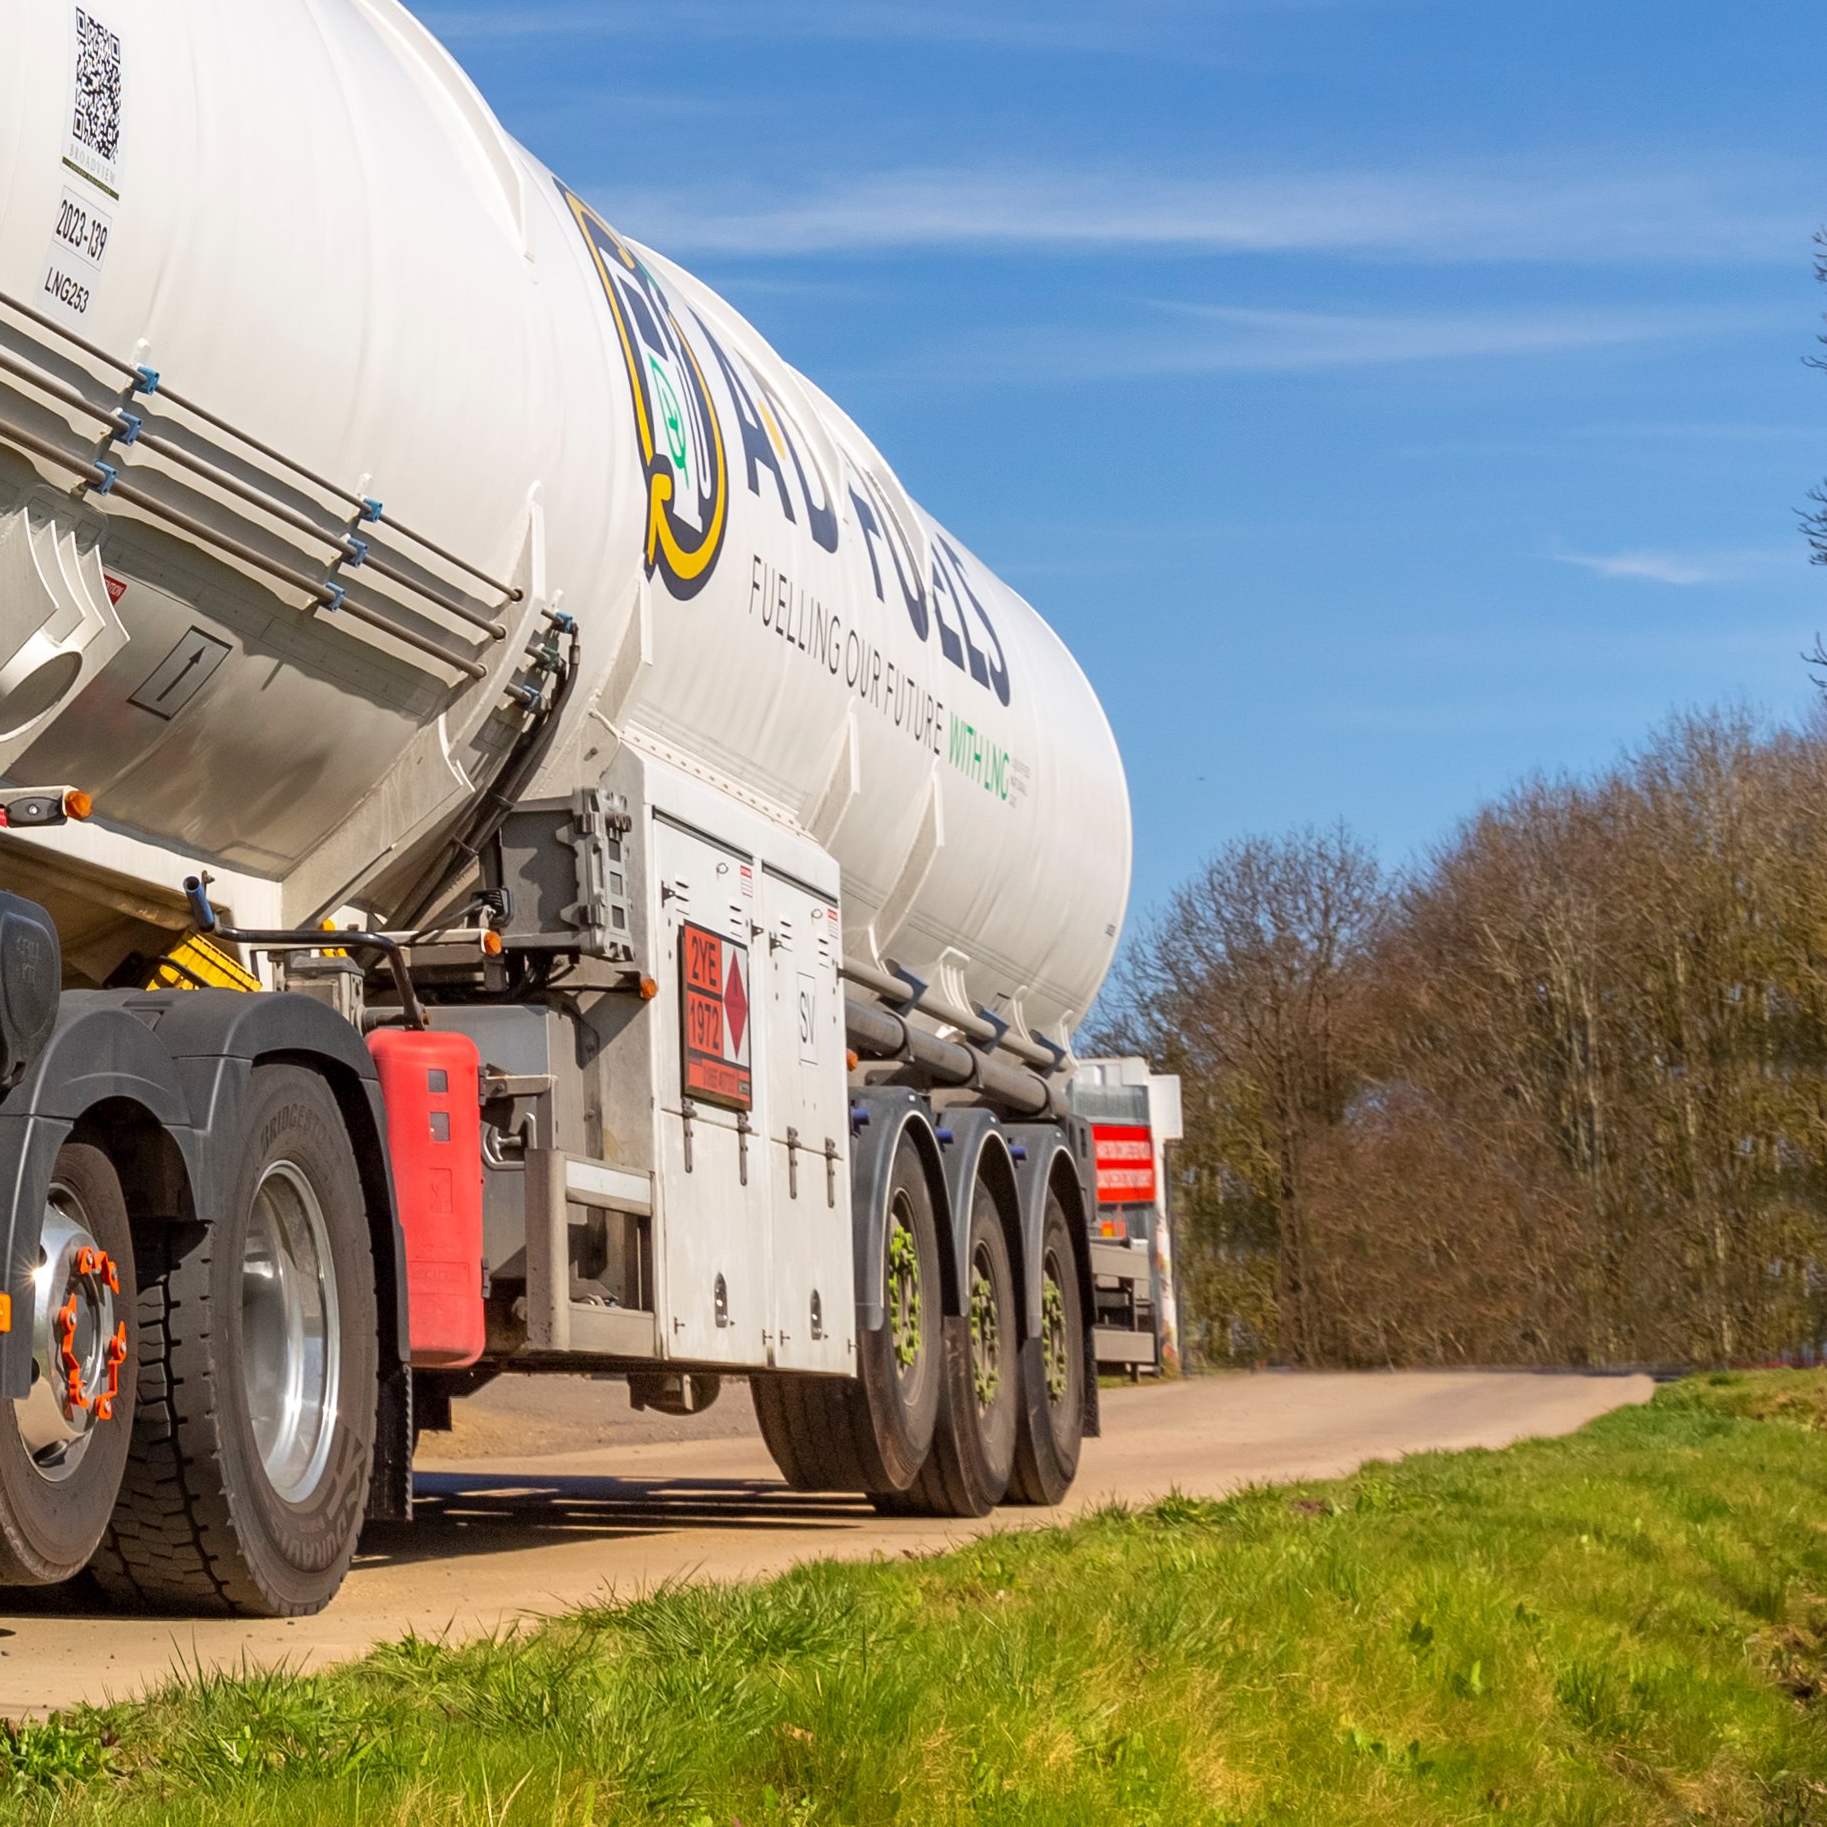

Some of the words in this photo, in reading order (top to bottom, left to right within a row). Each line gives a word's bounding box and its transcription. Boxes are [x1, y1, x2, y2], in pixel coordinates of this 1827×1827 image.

[68, 144, 117, 186] BROADVIEW
[55, 199, 108, 261] 2023-139
[44, 266, 90, 314] LNG253
[838, 444, 1010, 707] FUELS
[749, 554, 841, 675] FUELLING
[846, 629, 881, 709] OUR
[883, 661, 944, 756] FUTURE
[948, 710, 984, 784] WITH
[983, 738, 1010, 801] LNG
[691, 935, 717, 987] 2YE
[690, 998, 720, 1050] 1972
[799, 990, 817, 1045] SV
